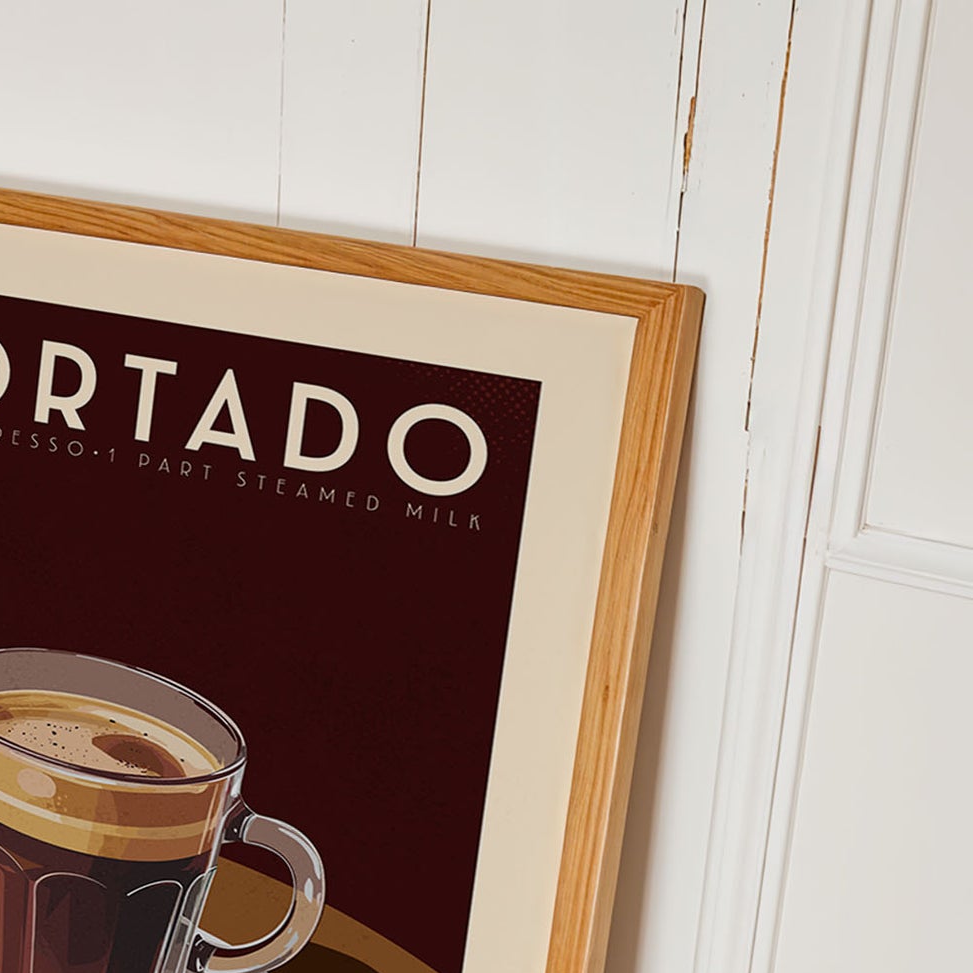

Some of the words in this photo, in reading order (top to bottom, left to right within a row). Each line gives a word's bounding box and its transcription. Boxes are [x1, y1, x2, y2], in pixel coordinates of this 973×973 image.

[138, 453, 213, 481] PART
[236, 471, 380, 511] STEAMED
[405, 502, 481, 531] MILK
